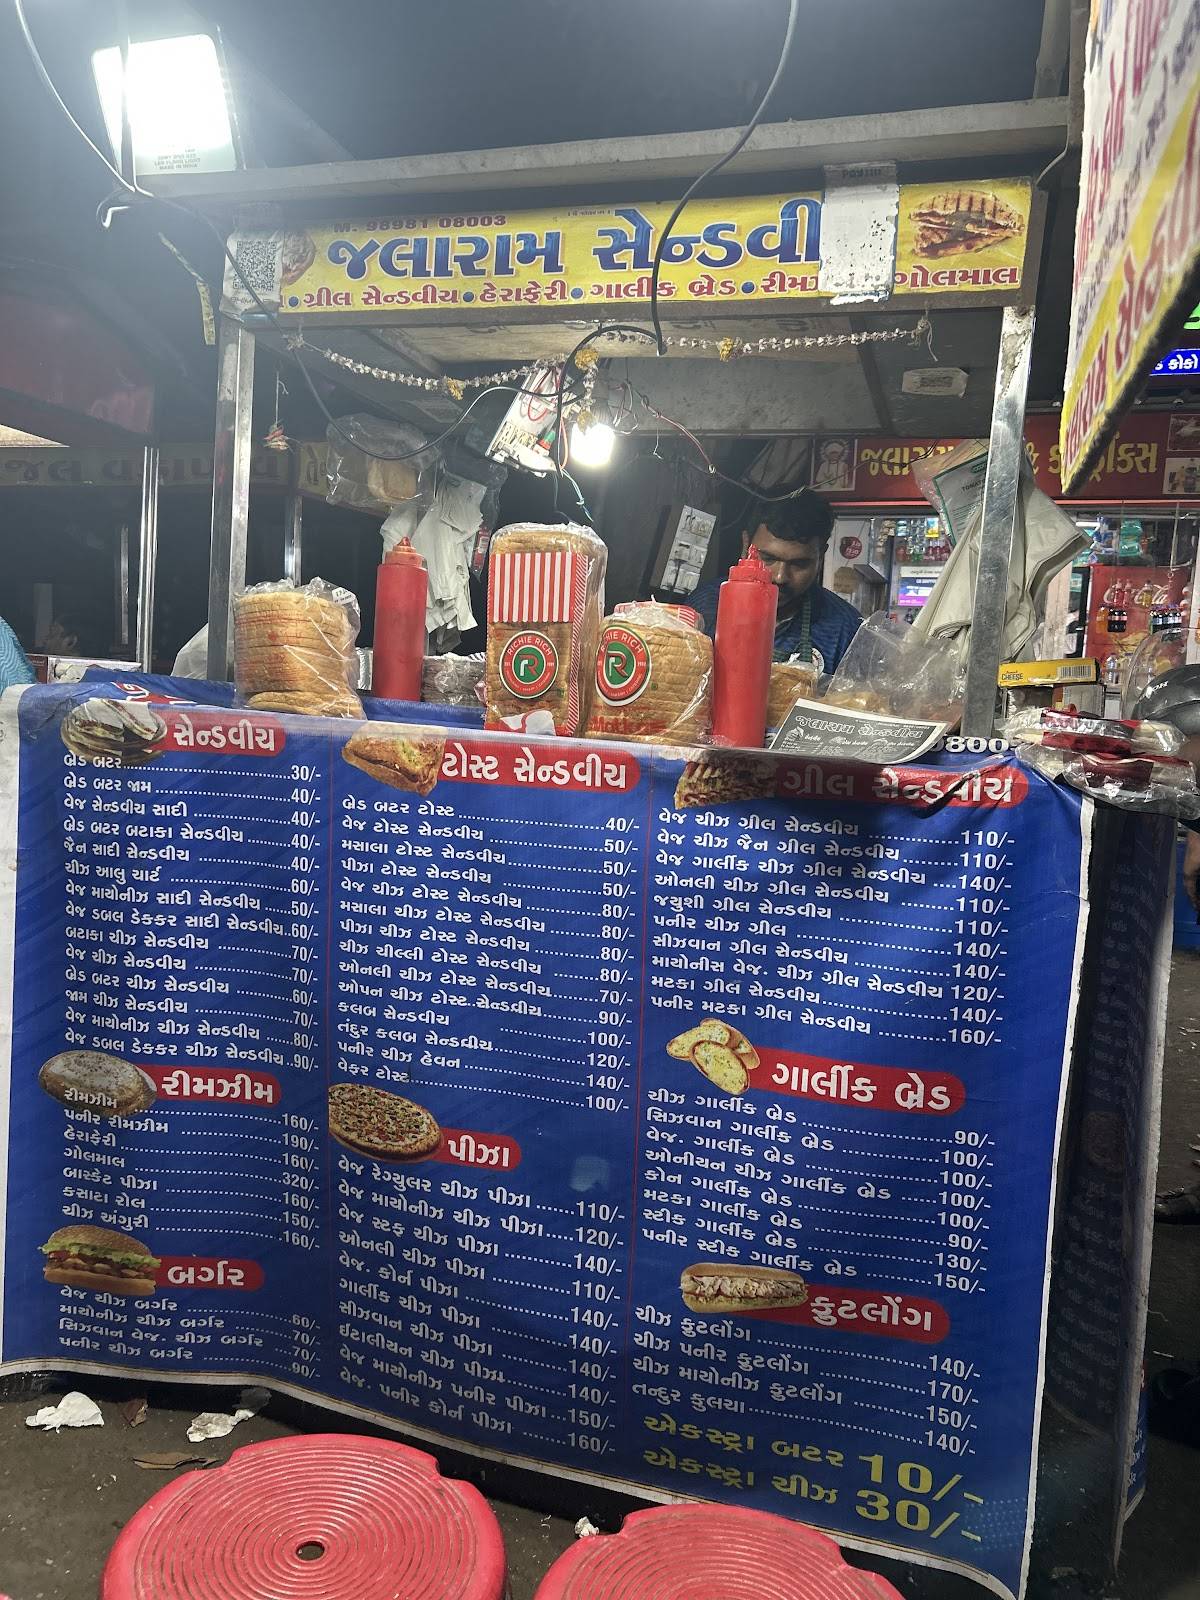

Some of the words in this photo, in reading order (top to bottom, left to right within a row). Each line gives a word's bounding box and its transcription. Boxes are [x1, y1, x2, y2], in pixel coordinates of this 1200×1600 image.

[327, 231, 564, 280] જલારામ
[592, 199, 821, 270] સેન્ડવી
[366, 217, 428, 232] 98981
[438, 214, 507, 228] 08003
[303, 287, 352, 307] ગ્રીલ
[360, 284, 458, 307] સેન્ડવીચ
[480, 280, 568, 303] હેરાફેરી
[688, 274, 736, 296] બ્રેડ
[894, 264, 1019, 288] ગોલમાલ
[507, 637, 532, 655] RICHIE
[534, 638, 553, 656] RICH
[621, 631, 645, 654] RICH
[1001, 673, 1023, 681] CHEESE
[174, 714, 274, 751] સેન્ડવીચ
[439, 743, 499, 780] ટોસ્ટ
[514, 747, 625, 788] સેન્ડવીચ
[64, 772, 87, 788] બ્રેડ
[93, 778, 121, 790] બટર
[128, 781, 151, 793] જામ
[292, 789, 320, 805] 40/-
[64, 793, 86, 809] વેજ
[92, 795, 145, 814] સેન્ડવીચ
[153, 801, 187, 816] સાદી
[292, 811, 320, 827] 40/-
[343, 795, 366, 810] બ્રેડ
[374, 802, 409, 813] બટર
[418, 801, 454, 816] ટોસ્ટ
[606, 818, 639, 833] 40/-
[343, 815, 366, 830] વેજ
[374, 819, 409, 834] ટોસ્ટ
[418, 821, 483, 840] સેન્ડવીચ
[604, 839, 638, 855] 50/-
[659, 808, 687, 824] વેજ
[695, 812, 729, 827] ચીઝ
[738, 815, 775, 830] ગ્રીલ
[784, 816, 857, 835] સેન્ડવીચ
[961, 831, 1014, 848] 110/-
[64, 836, 86, 853] જૈન
[92, 842, 119, 857] સાદી
[126, 842, 189, 861] સેન્ડવીચ
[291, 857, 319, 873] 40/-
[342, 840, 388, 853] મસાલા
[396, 841, 432, 857] ટોસ્ટ
[441, 844, 505, 864] સેન્ડવીચ
[604, 861, 636, 877] 50/-
[65, 859, 89, 875] ચીઝ
[292, 879, 319, 896] 60/-
[66, 927, 103, 941] બટાકા
[109, 930, 136, 945] ચીઝ
[144, 931, 208, 949] સેન્ડવીચ
[292, 945, 318, 963] 70/-
[654, 914, 696, 928] પનીર
[705, 917, 739, 932] ચીઝ
[748, 920, 785, 936] ગ્રીલ
[954, 942, 1007, 959] 140/-
[66, 990, 87, 1003] જામ
[93, 992, 118, 1008] ચીઝ
[125, 994, 187, 1013] સેન્ડવીચ
[293, 1011, 318, 1029] 70/-
[652, 976, 694, 990] મટકા
[703, 979, 740, 994] ગ્રીલ
[749, 981, 819, 1003] સેન્ડવીચ
[950, 1007, 1003, 1024] 140/-
[162, 1070, 272, 1103] રીમઝીમ
[338, 1042, 373, 1056] પનીર
[381, 1047, 412, 1062] ચીઝ
[420, 1051, 460, 1068] હેવન
[587, 1074, 629, 1091] 140/-
[338, 1057, 368, 1076] વેફર
[376, 1065, 409, 1082] ટોસ્ટ
[586, 1095, 629, 1112] 100/-
[772, 1063, 876, 1102] ગાર્લીક
[895, 1073, 950, 1110] બ્રેડ
[64, 1109, 100, 1124] પનીર
[108, 1115, 168, 1132] રીમઝીમ
[283, 1133, 319, 1152] 190/-
[648, 1088, 685, 1104] ચીઝ
[695, 1096, 757, 1114] ગાર્લીક
[766, 1104, 796, 1123] બ્રેડ
[955, 1131, 994, 1148] 90/-
[64, 1124, 115, 1146] હેરાફેરી
[283, 1153, 319, 1172] 160/-
[64, 1145, 124, 1167] ગોલમાલ
[283, 1172, 319, 1192] 320/-
[448, 1135, 509, 1166] પીઝા
[283, 1211, 319, 1230] 150/-
[339, 1179, 364, 1199] વેજ
[453, 1209, 490, 1227] ચીઝ
[501, 1215, 543, 1236] પીઝા
[576, 1227, 623, 1249] 120/-
[645, 1167, 681, 1184] કોન
[691, 1177, 751, 1197] ગાર્લીક
[761, 1187, 792, 1206] બ્રેડ
[938, 1212, 989, 1231] 100/-
[62, 1203, 93, 1219] ચીઝ
[283, 1231, 319, 1250] 160/-
[643, 1208, 686, 1225] સ્ટીક
[695, 1218, 755, 1240] ગાર્લીક
[765, 1230, 797, 1248] બ્રેડ
[935, 1253, 986, 1273] 130/-
[168, 1261, 244, 1285] બર્ગર
[339, 1230, 394, 1257] ઓનલી
[402, 1248, 436, 1267] ચીઝ
[445, 1258, 484, 1279] પીઝા
[573, 1280, 620, 1303] 110/-
[61, 1285, 87, 1299] વેજ
[95, 1293, 126, 1306] ચીઝ
[135, 1298, 177, 1310] બર્ગર
[293, 1314, 320, 1330] 60/-
[340, 1278, 390, 1302] ગાર્લીક
[399, 1295, 432, 1315] ચીઝ
[441, 1306, 479, 1328] પીઝા
[569, 1334, 616, 1356] 140/-
[635, 1305, 671, 1326] ચીઝ
[929, 1355, 980, 1380] 140/-
[925, 1431, 975, 1456] 140/-
[772, 1441, 843, 1467] બટર
[857, 1455, 983, 1507] 10/-
[772, 1475, 838, 1503] ચીઝ
[856, 1486, 983, 1542] 30/-
